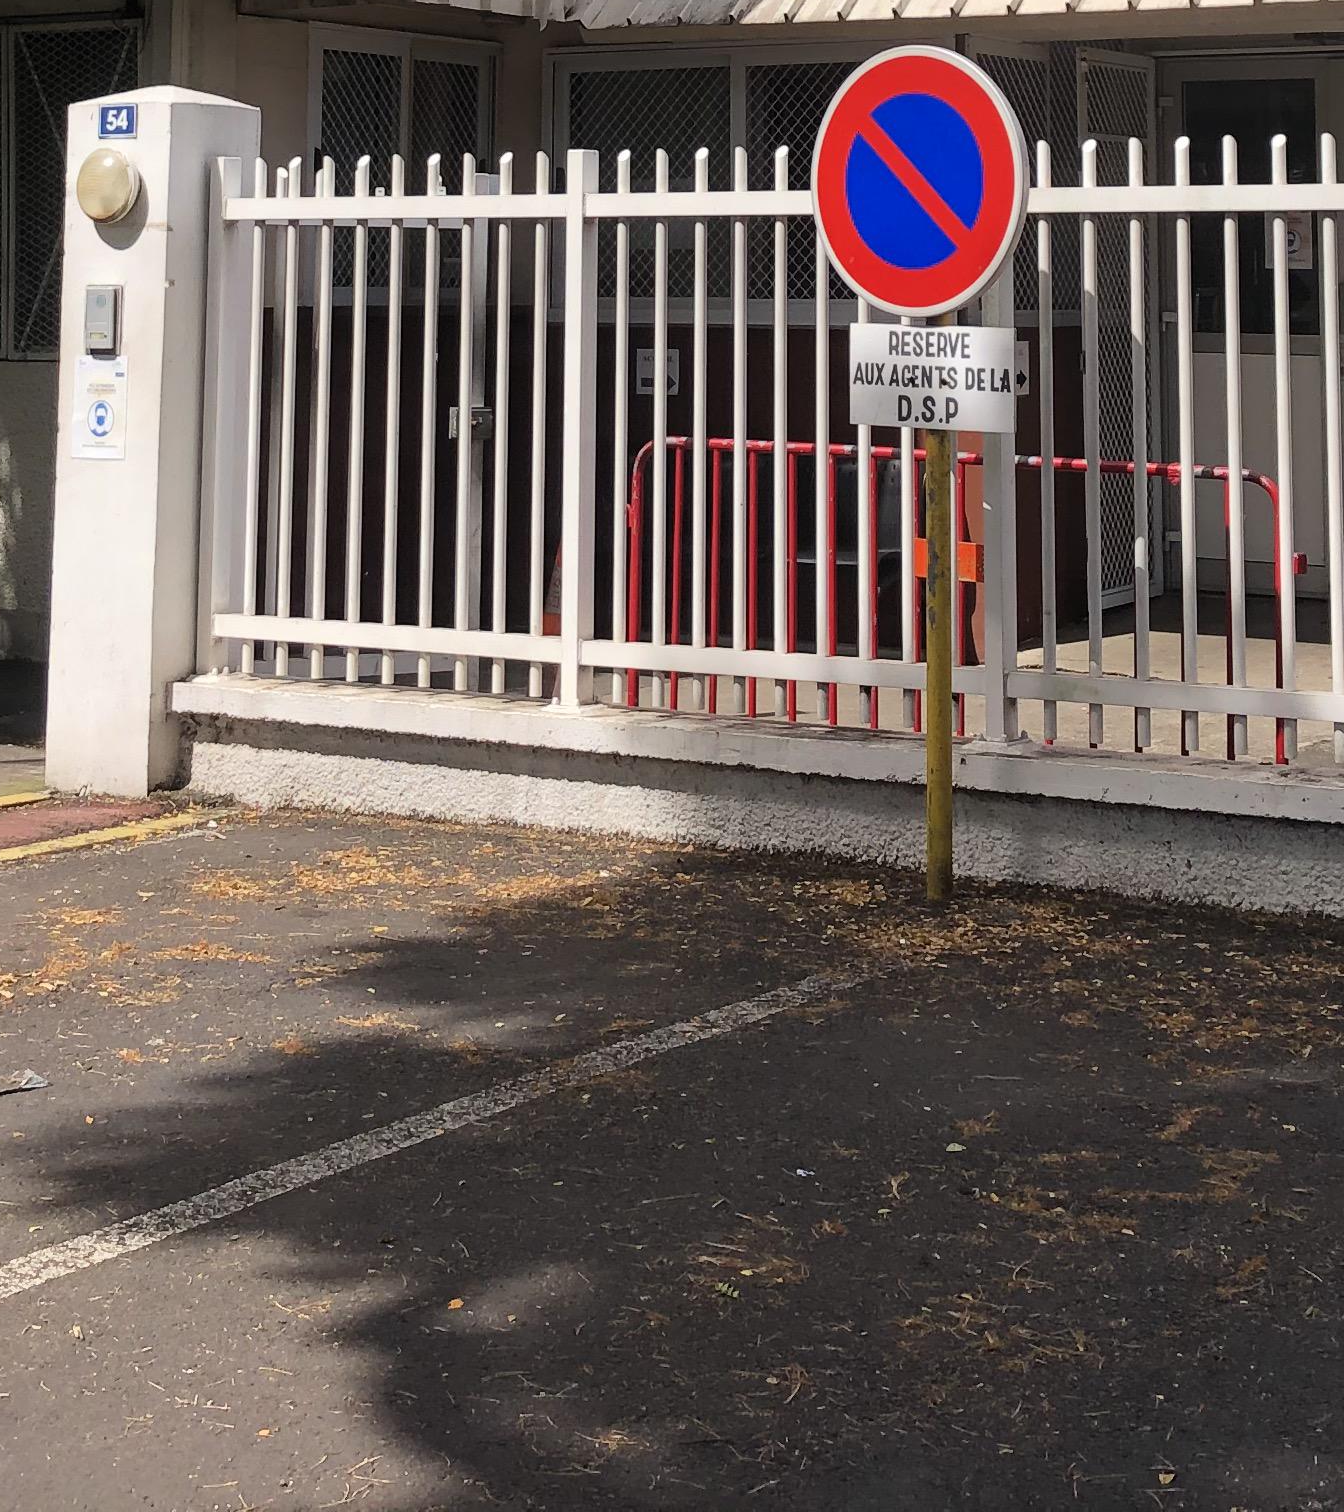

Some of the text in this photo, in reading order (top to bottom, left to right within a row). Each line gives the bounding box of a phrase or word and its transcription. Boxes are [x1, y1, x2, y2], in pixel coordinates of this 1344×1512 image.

[106, 109, 128, 131] 54
[888, 330, 971, 359] RESERVE
[853, 361, 1012, 393] AUX AGENTS DE LA
